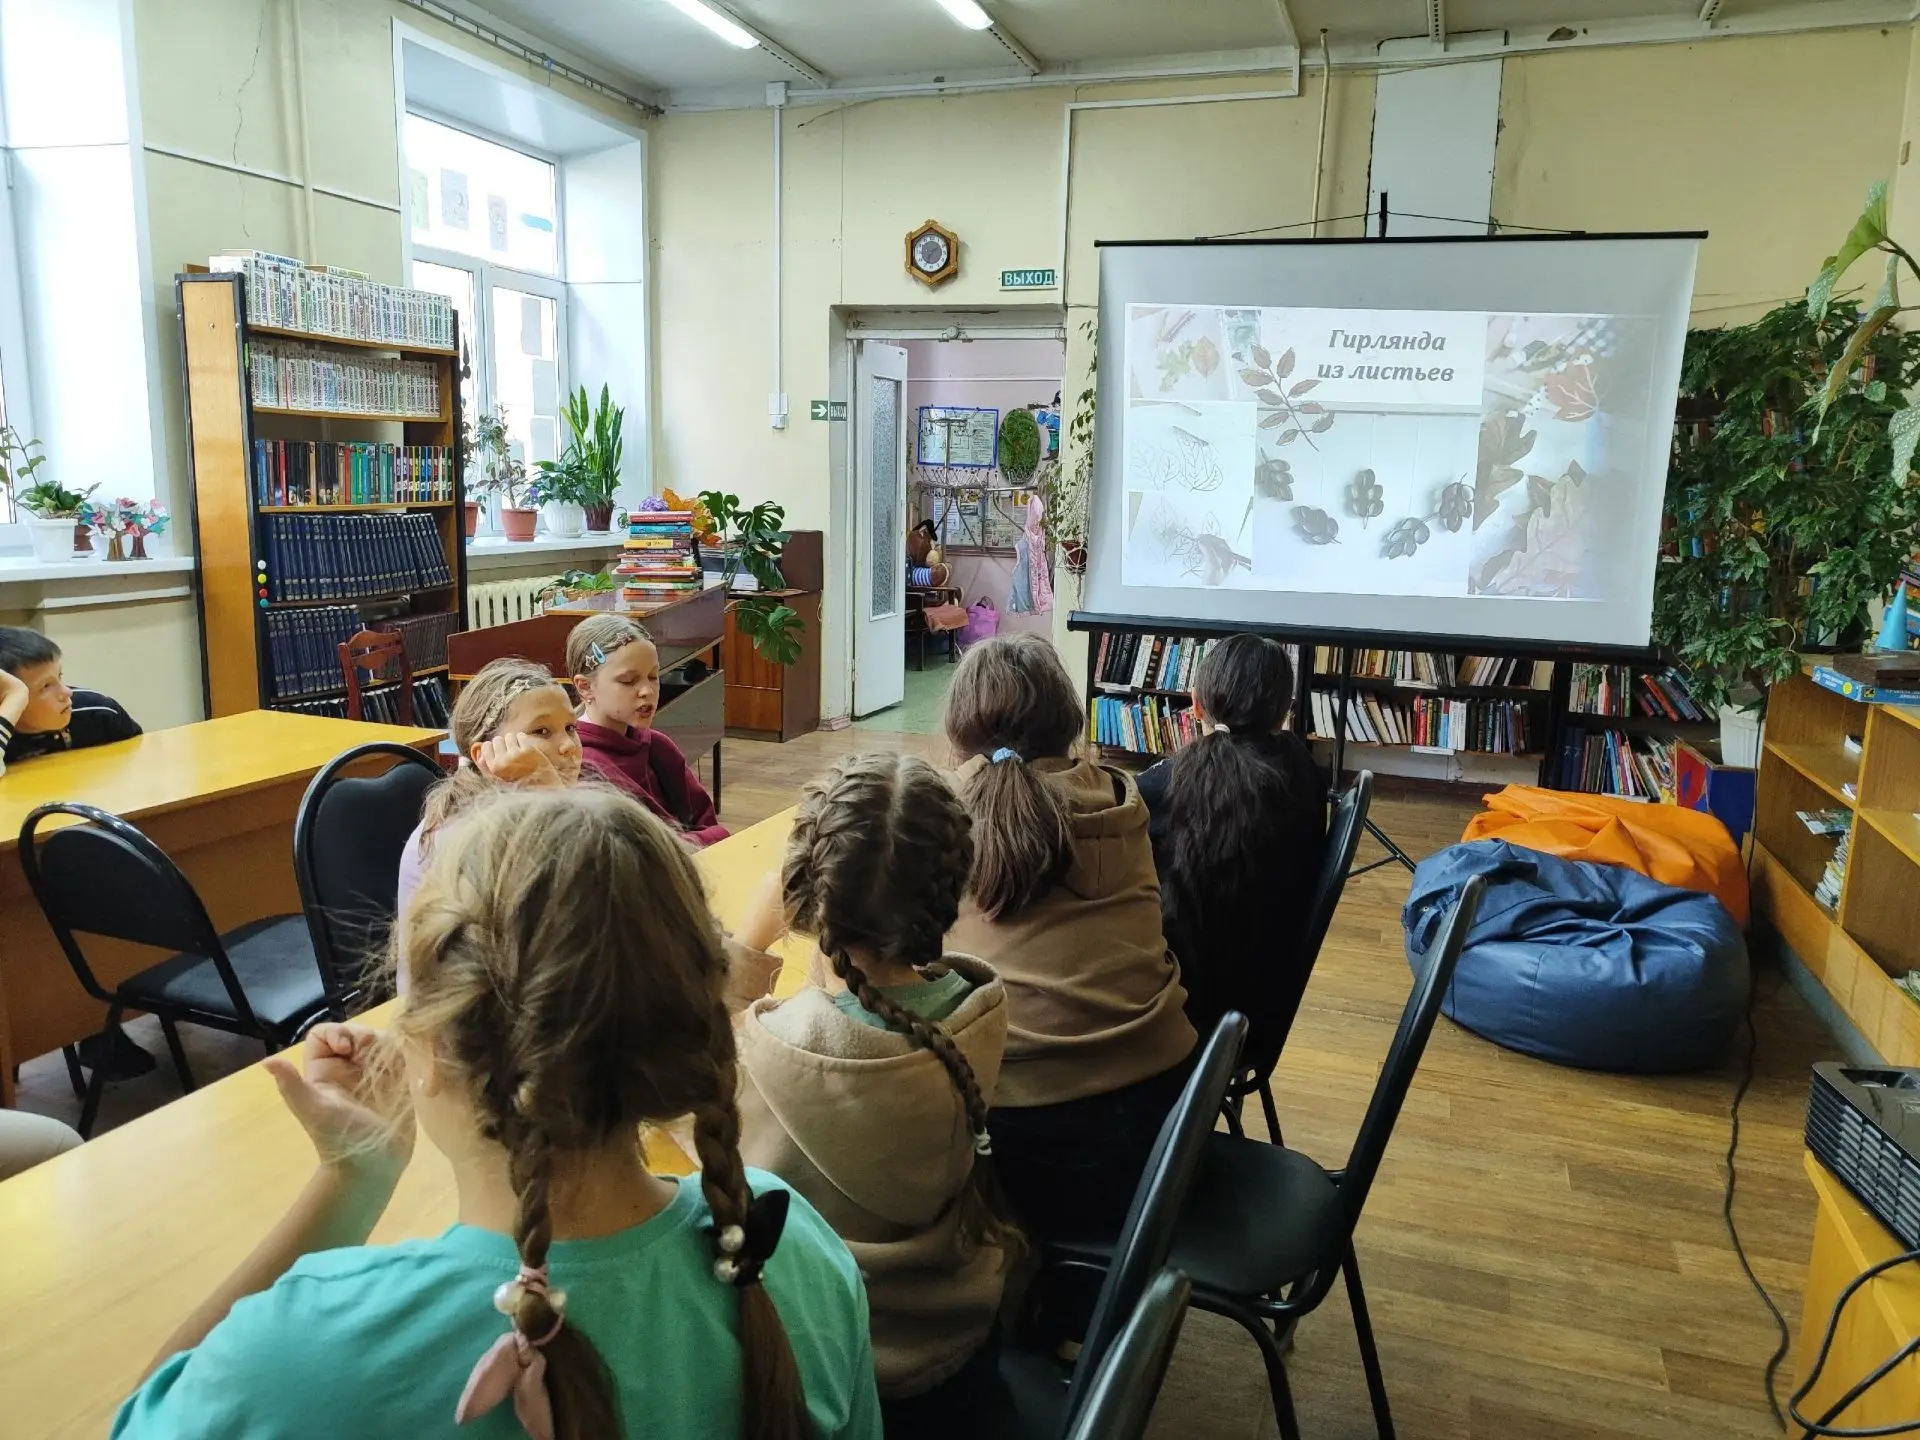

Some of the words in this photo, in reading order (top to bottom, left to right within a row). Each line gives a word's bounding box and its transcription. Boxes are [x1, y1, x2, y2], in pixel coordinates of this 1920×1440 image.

[1004, 271, 1054, 286] ВЫХОД
[1328, 329, 1447, 354] Гирлянда
[1317, 363, 1345, 379] из
[1348, 364, 1455, 382] листьев
